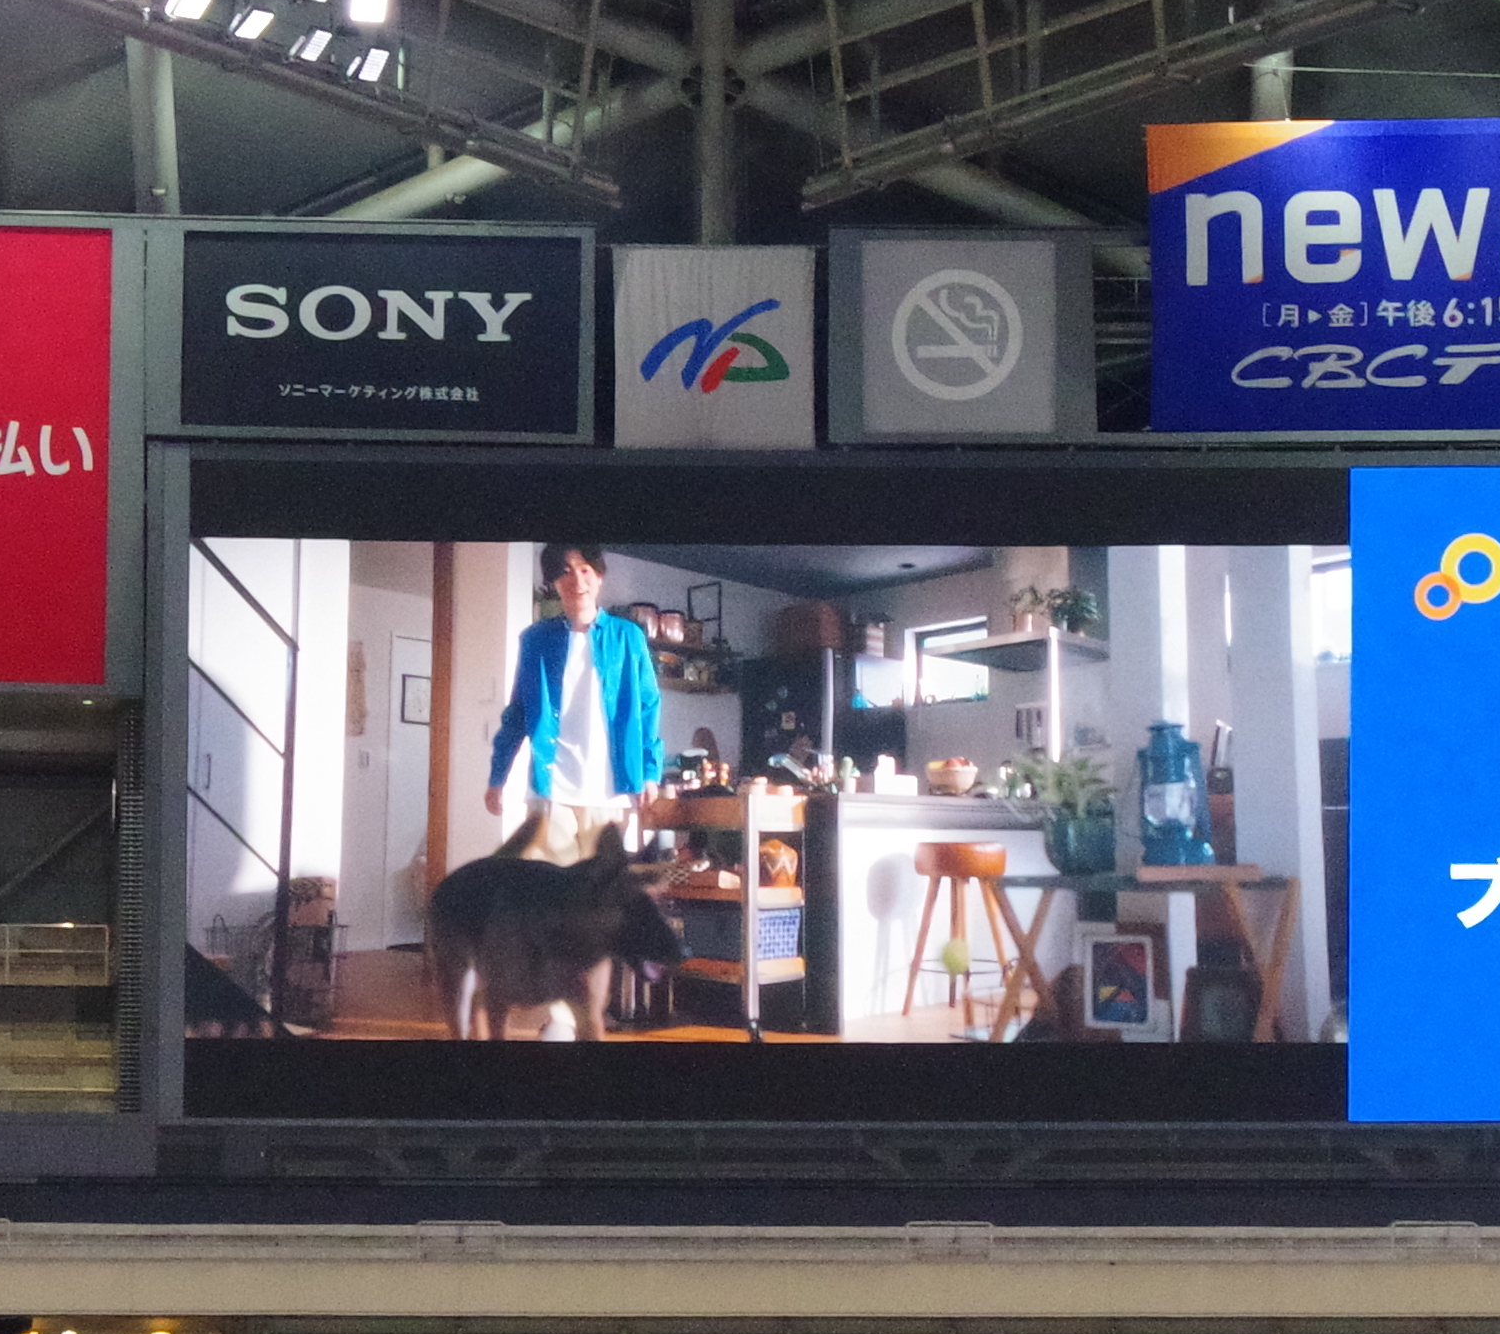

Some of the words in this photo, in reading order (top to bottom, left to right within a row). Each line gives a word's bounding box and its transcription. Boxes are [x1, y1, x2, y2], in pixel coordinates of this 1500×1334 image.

[225, 283, 532, 342] SONY
[278, 383, 480, 402] ソニーマーケティング株式会社
